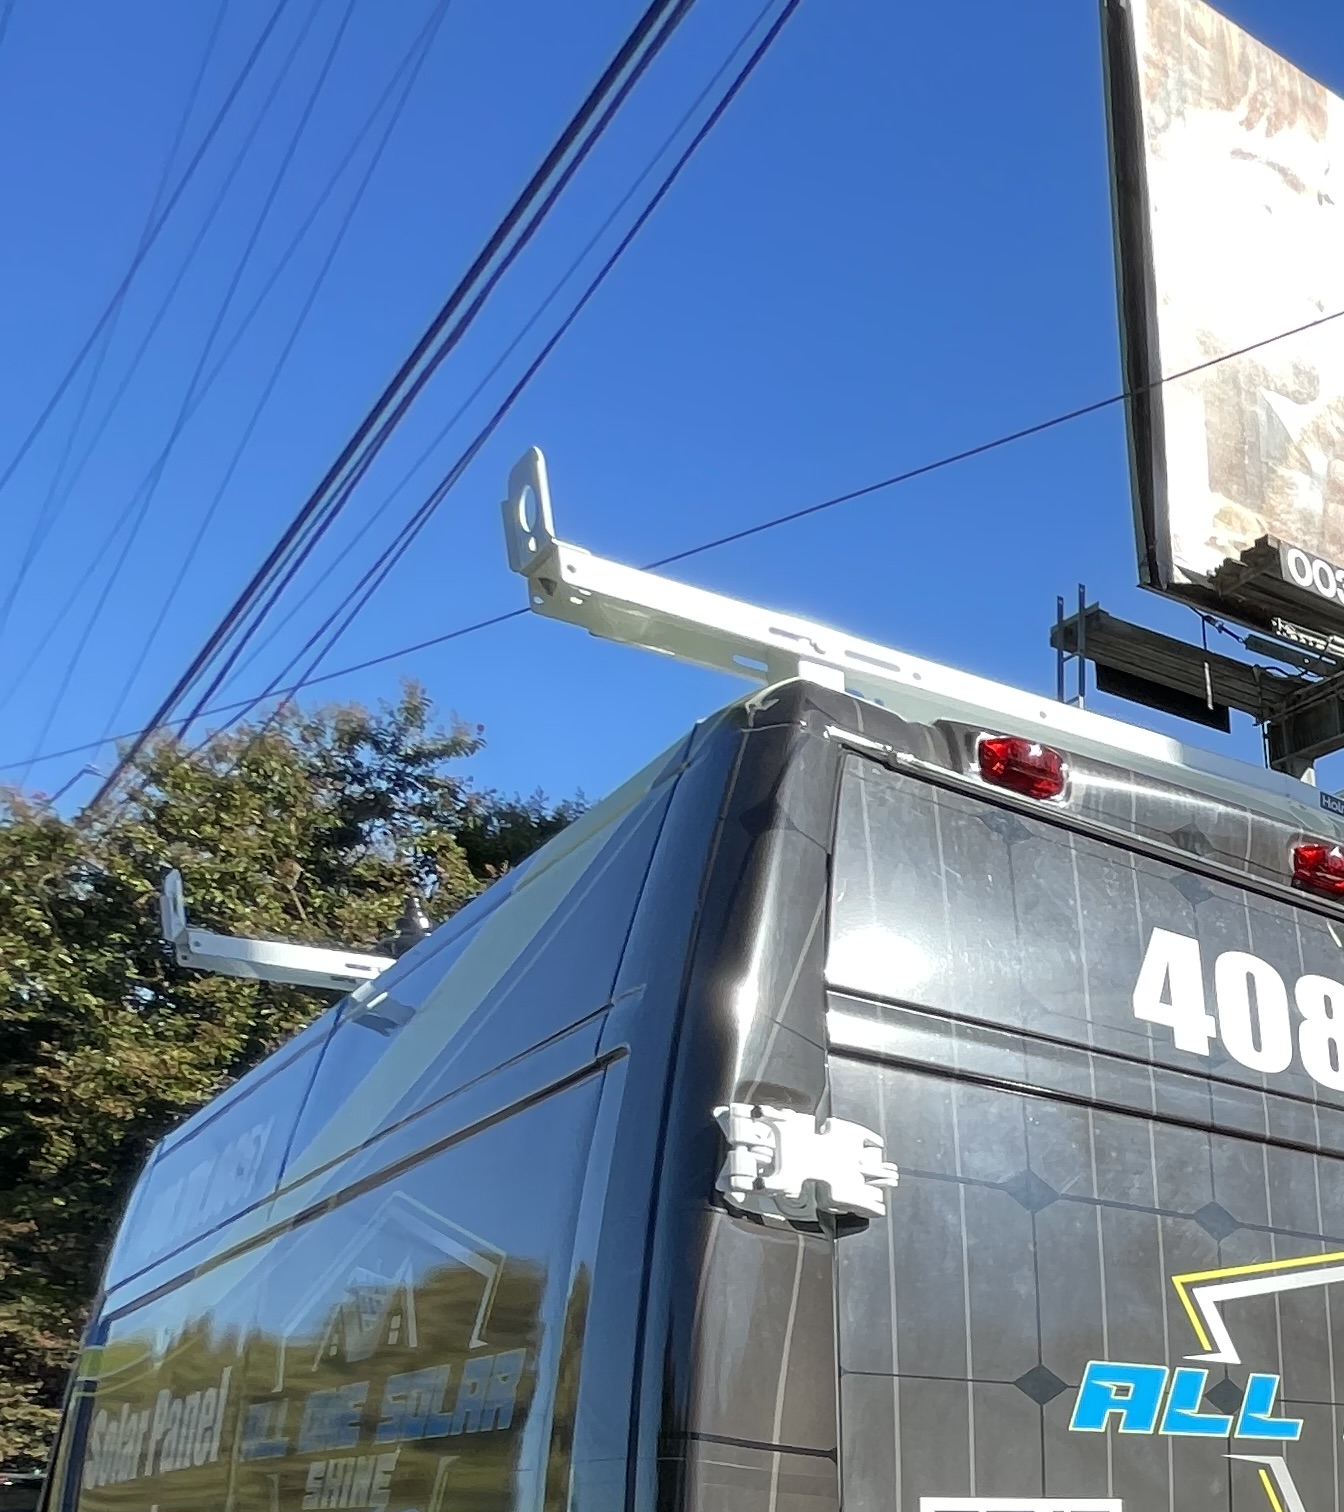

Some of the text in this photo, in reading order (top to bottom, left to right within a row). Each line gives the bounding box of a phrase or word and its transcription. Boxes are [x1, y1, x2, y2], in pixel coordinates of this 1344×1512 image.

[145, 1366, 232, 1477] Panel
[374, 1348, 527, 1445] SOLAR
[1068, 1358, 1307, 1442] ALL
[302, 1450, 397, 1510] SHINE
